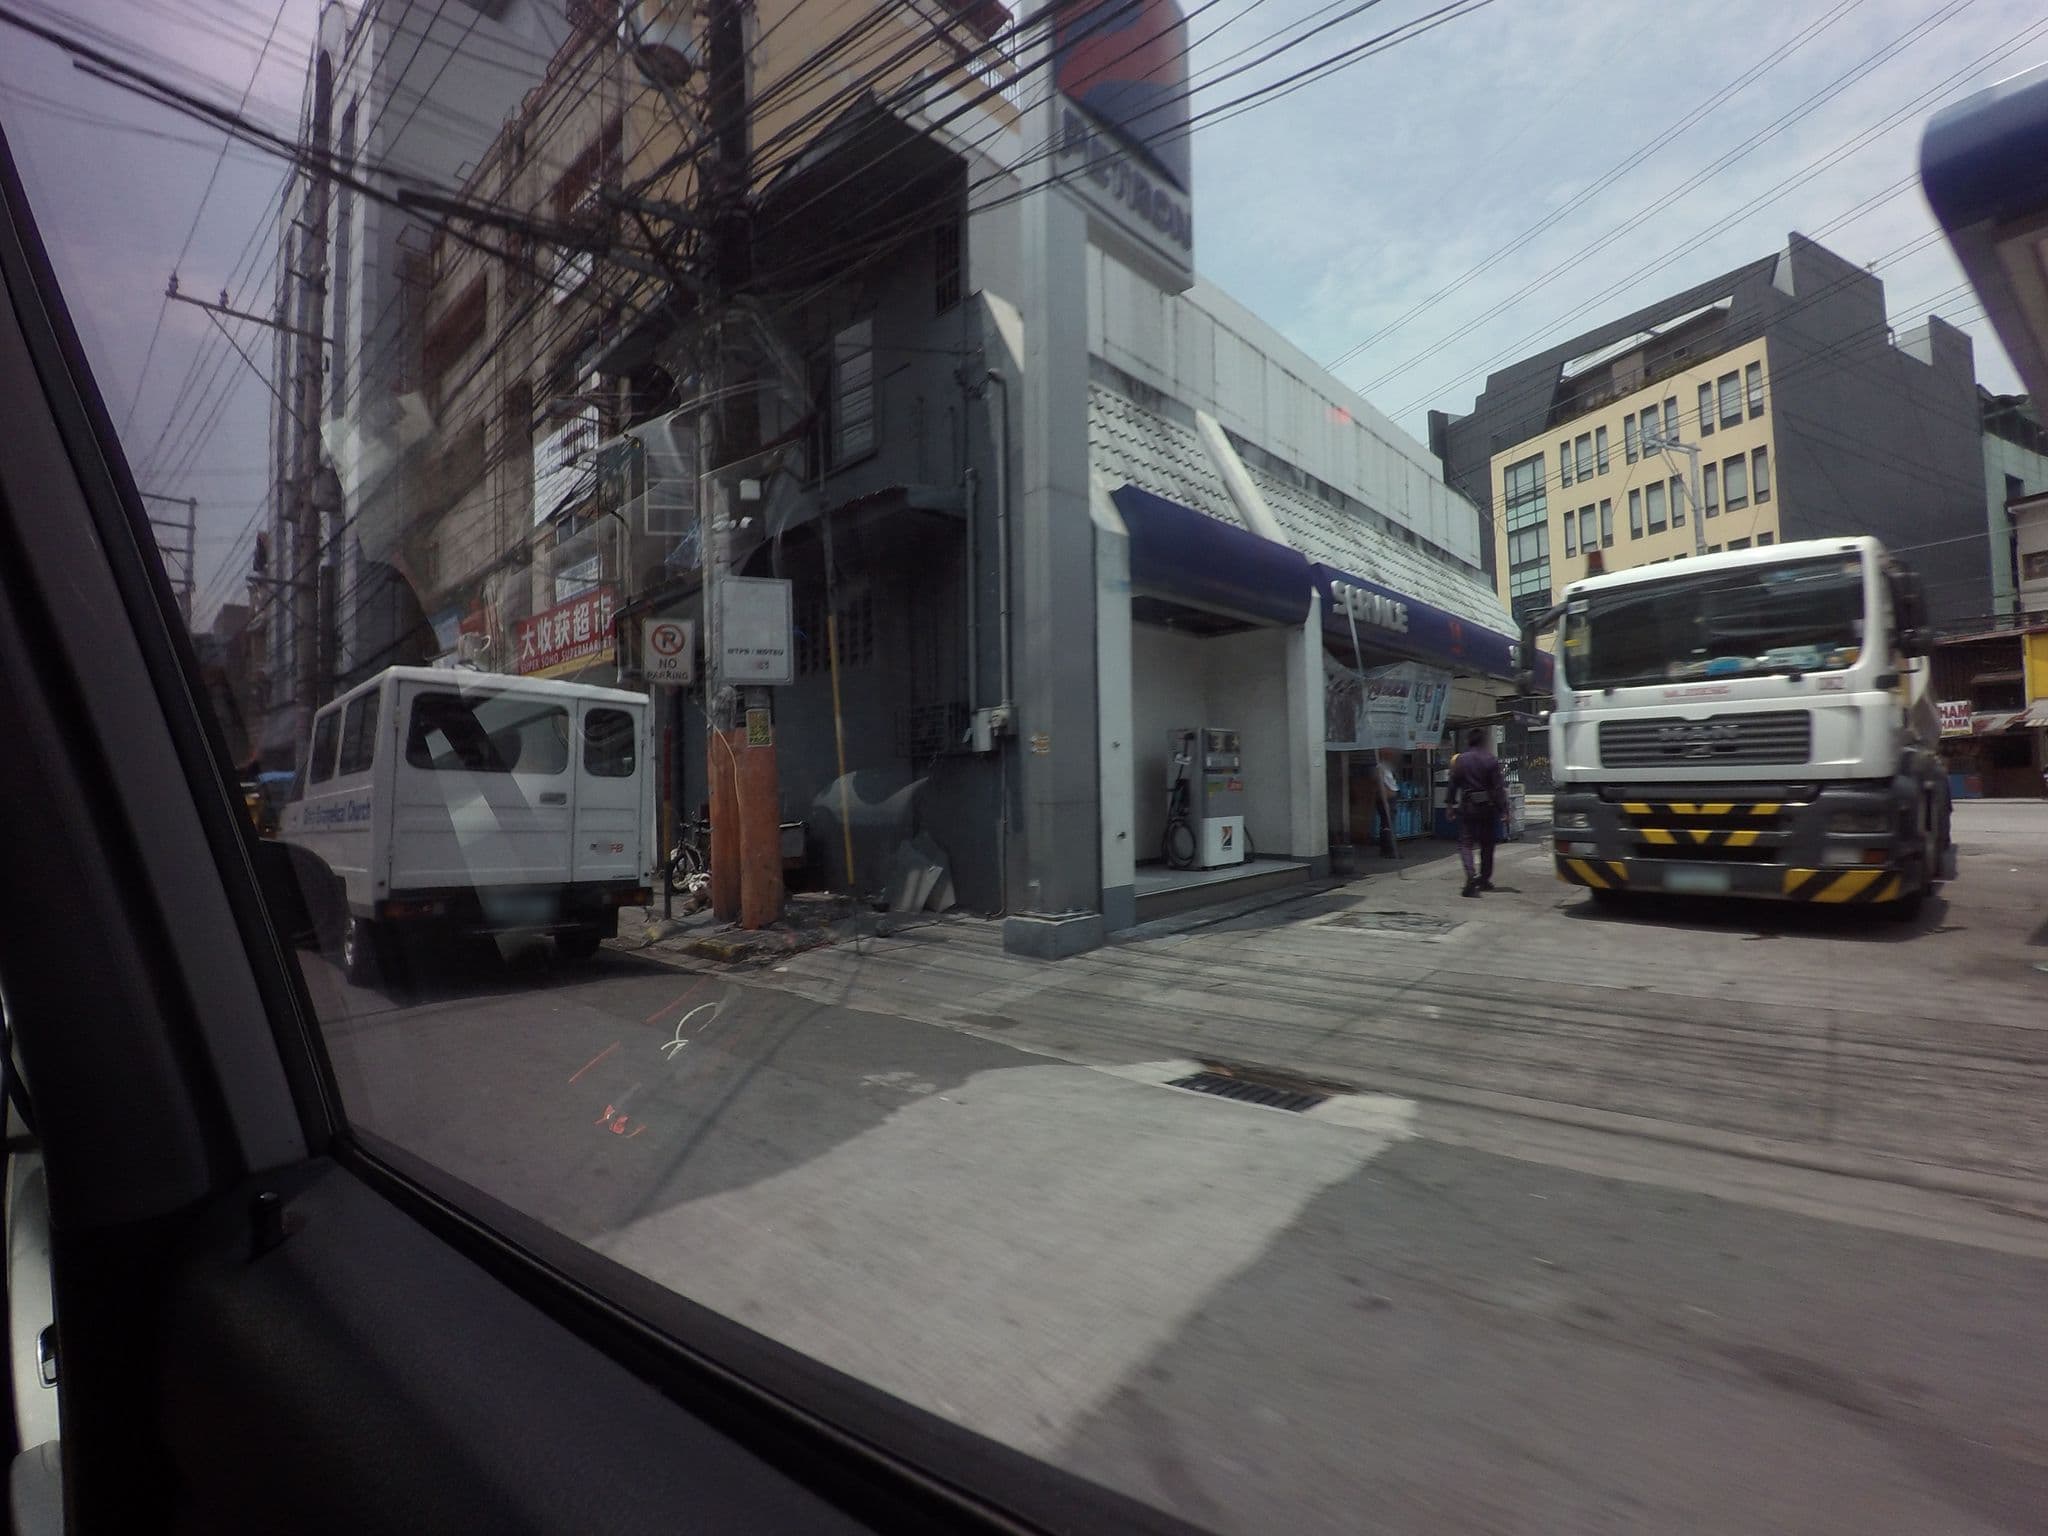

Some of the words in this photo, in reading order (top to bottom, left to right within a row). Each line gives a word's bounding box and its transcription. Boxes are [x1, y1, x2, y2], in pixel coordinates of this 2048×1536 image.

[1330, 579, 1409, 634] SERVICE
[658, 658, 677, 669] NO
[647, 671, 688, 681] PARKING
